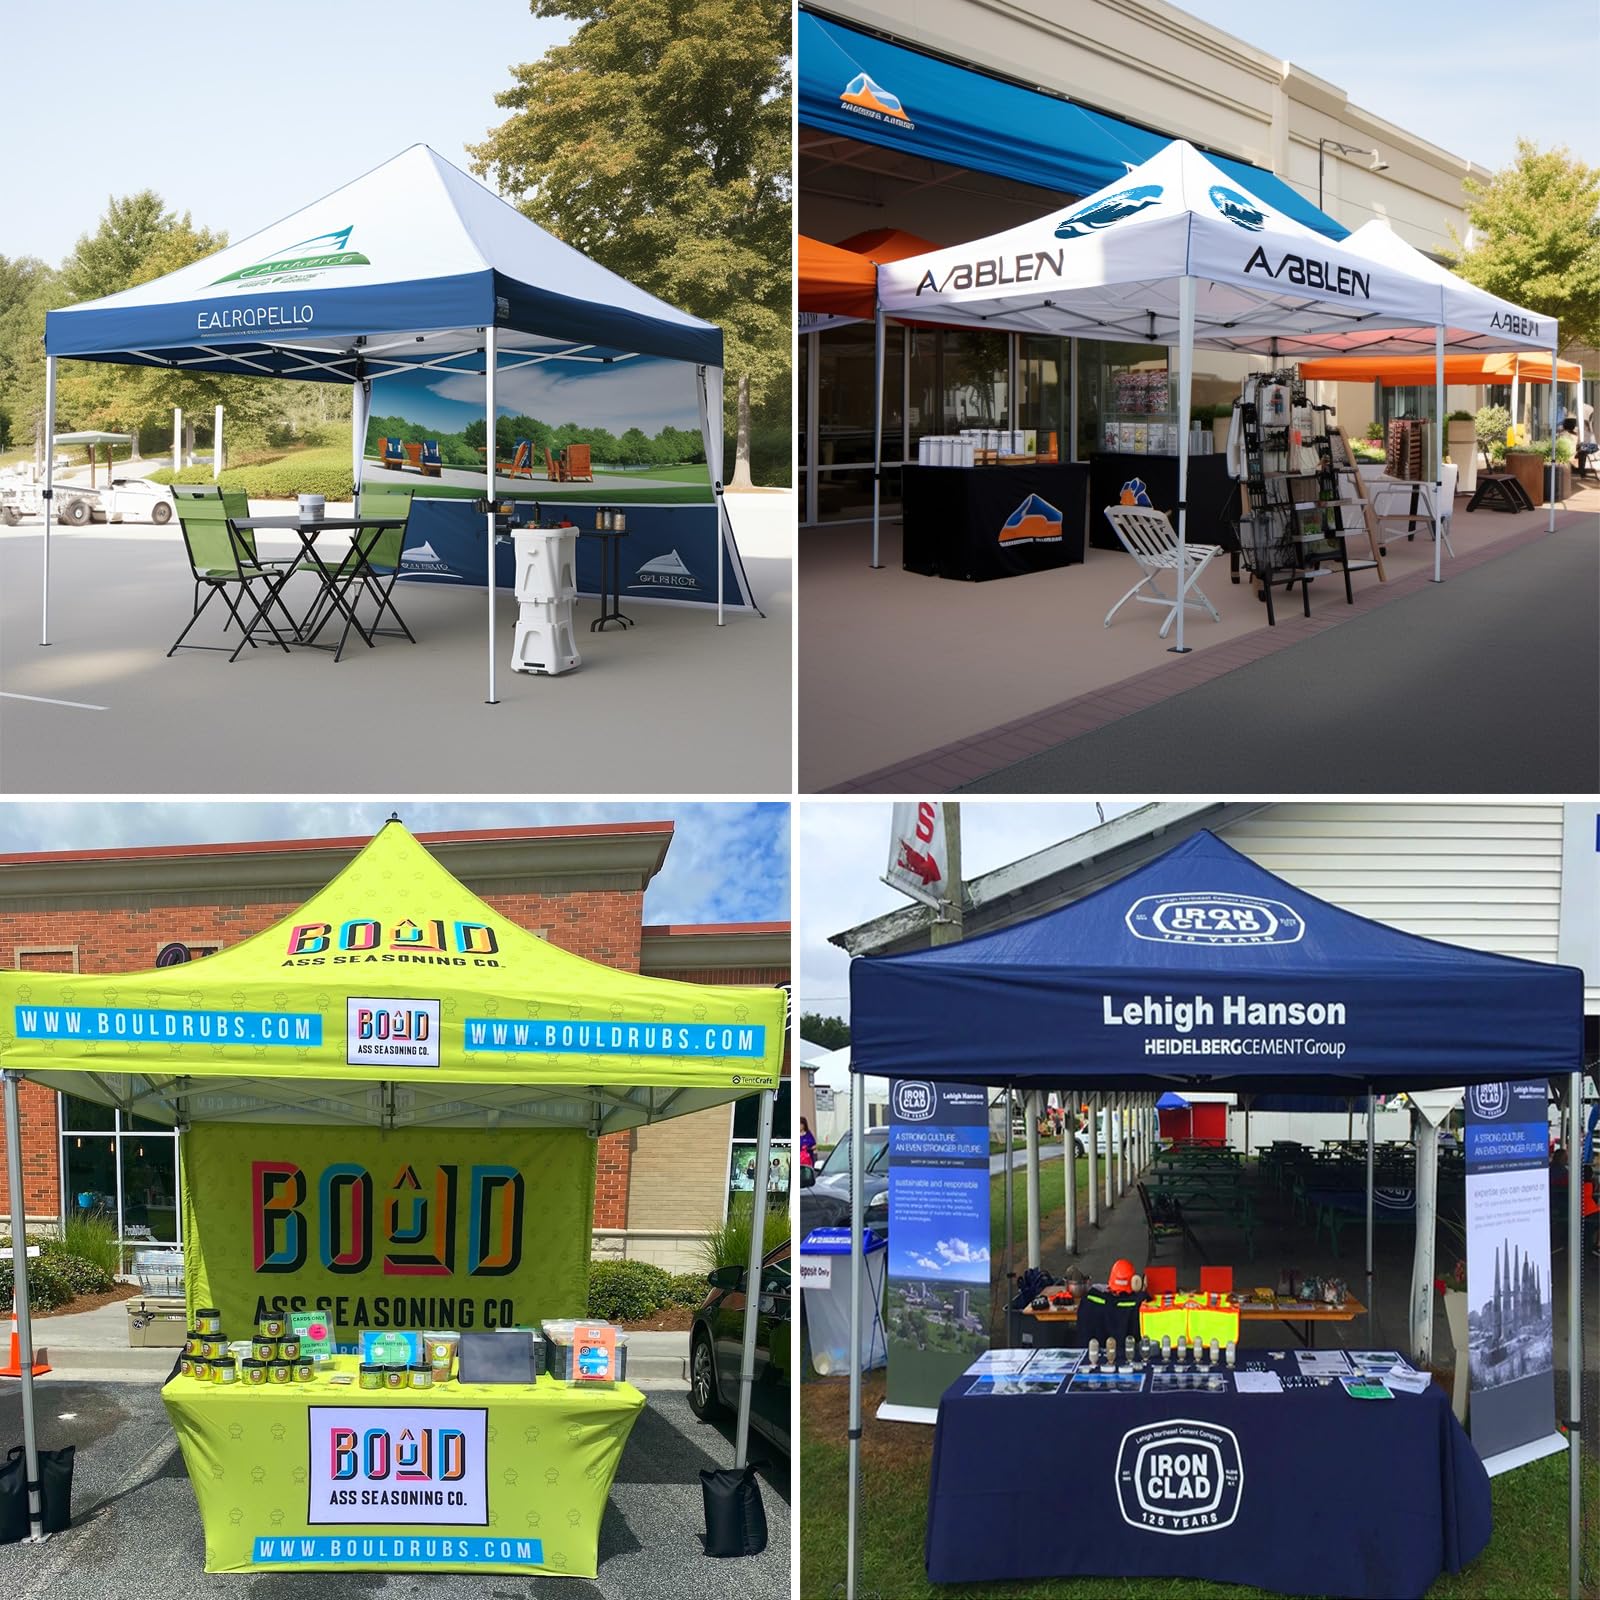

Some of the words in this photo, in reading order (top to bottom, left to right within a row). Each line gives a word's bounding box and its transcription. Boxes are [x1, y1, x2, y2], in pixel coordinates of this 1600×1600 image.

[1175, 908, 1254, 920] IRON
[1171, 918, 1261, 931] CLAD
[281, 957, 326, 967] ASS
[333, 953, 467, 967] SEASONING
[473, 958, 507, 968] CO.
[1103, 995, 1214, 1033] Lehigh
[1222, 995, 1346, 1025] Hanson
[21, 1010, 310, 1040] WWW.BOULDRUBS.COM
[470, 1023, 754, 1051] WWW.BOULDRUBS.COM
[358, 1045, 373, 1054] ASS
[374, 1045, 417, 1055] SEASONING
[418, 1046, 430, 1056] CO.
[1304, 1038, 1346, 1059] Group
[742, 1076, 773, 1085] TentCraft
[1480, 1082, 1499, 1093] IRON
[904, 1089, 925, 1100] IRON
[943, 1092, 962, 1101] Lehigh
[1480, 1092, 1500, 1103] CLAD
[903, 1098, 926, 1108] CLAD
[901, 1133, 927, 1142] STRONG
[905, 1143, 922, 1152] EVEN
[922, 1143, 957, 1153] STRONGER
[930, 1179, 942, 1188] and
[800, 1264, 817, 1279] eposit
[484, 1298, 522, 1329] CO.
[1136, 1433, 1153, 1445] Lehigh
[1153, 1428, 1179, 1440] Northeast
[1179, 1427, 1199, 1435] Cement
[1199, 1429, 1223, 1444] Company
[1150, 1454, 1208, 1477] IRON
[1147, 1476, 1211, 1499] CLAD
[329, 1490, 357, 1505] ASS
[361, 1490, 443, 1506] SEASONING
[447, 1491, 467, 1506] CO.
[1142, 1512, 1165, 1526] 125
[1172, 1513, 1218, 1528] YEARS
[260, 1539, 532, 1559] WWW.BOULDRUBS.COM
